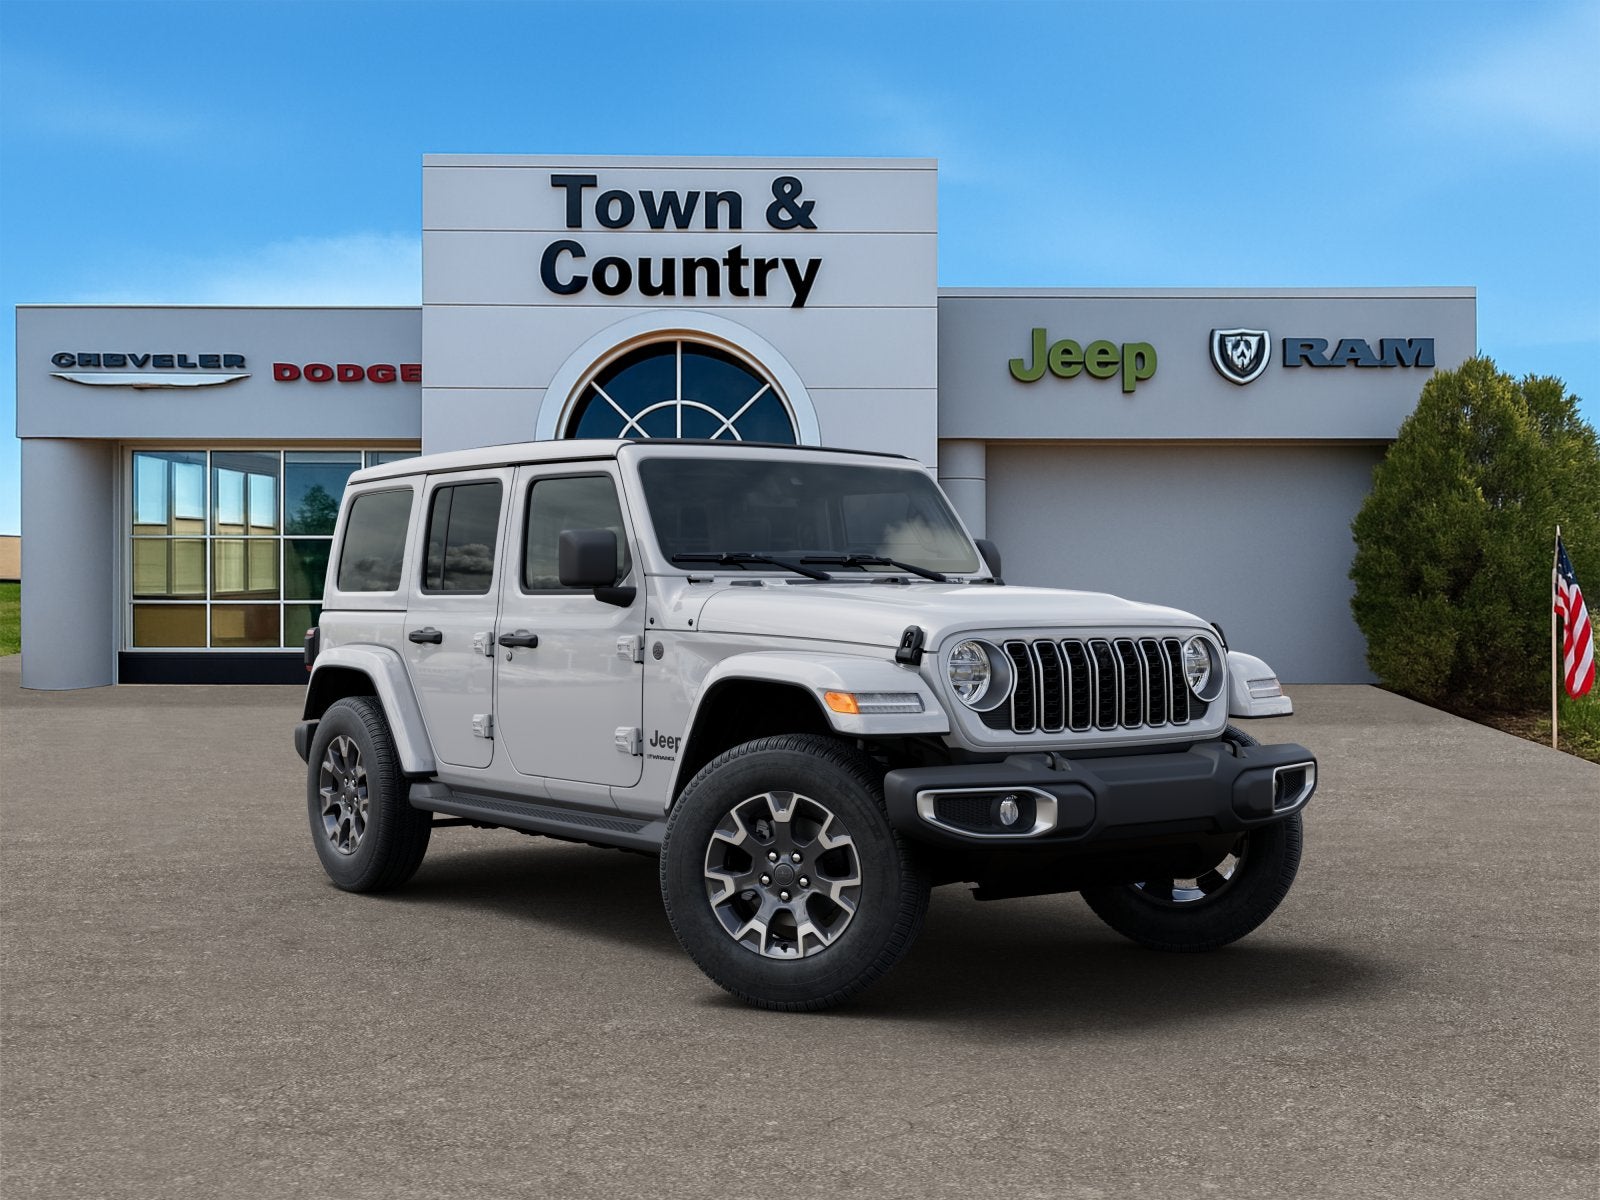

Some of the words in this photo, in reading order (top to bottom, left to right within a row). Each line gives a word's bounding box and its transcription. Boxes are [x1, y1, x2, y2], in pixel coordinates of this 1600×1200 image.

[551, 174, 742, 229] Town
[766, 176, 818, 230] &
[540, 239, 822, 308] Country
[273, 363, 422, 383] DODGE
[1009, 328, 1158, 393] Jeep
[1283, 338, 1435, 368] RAM
